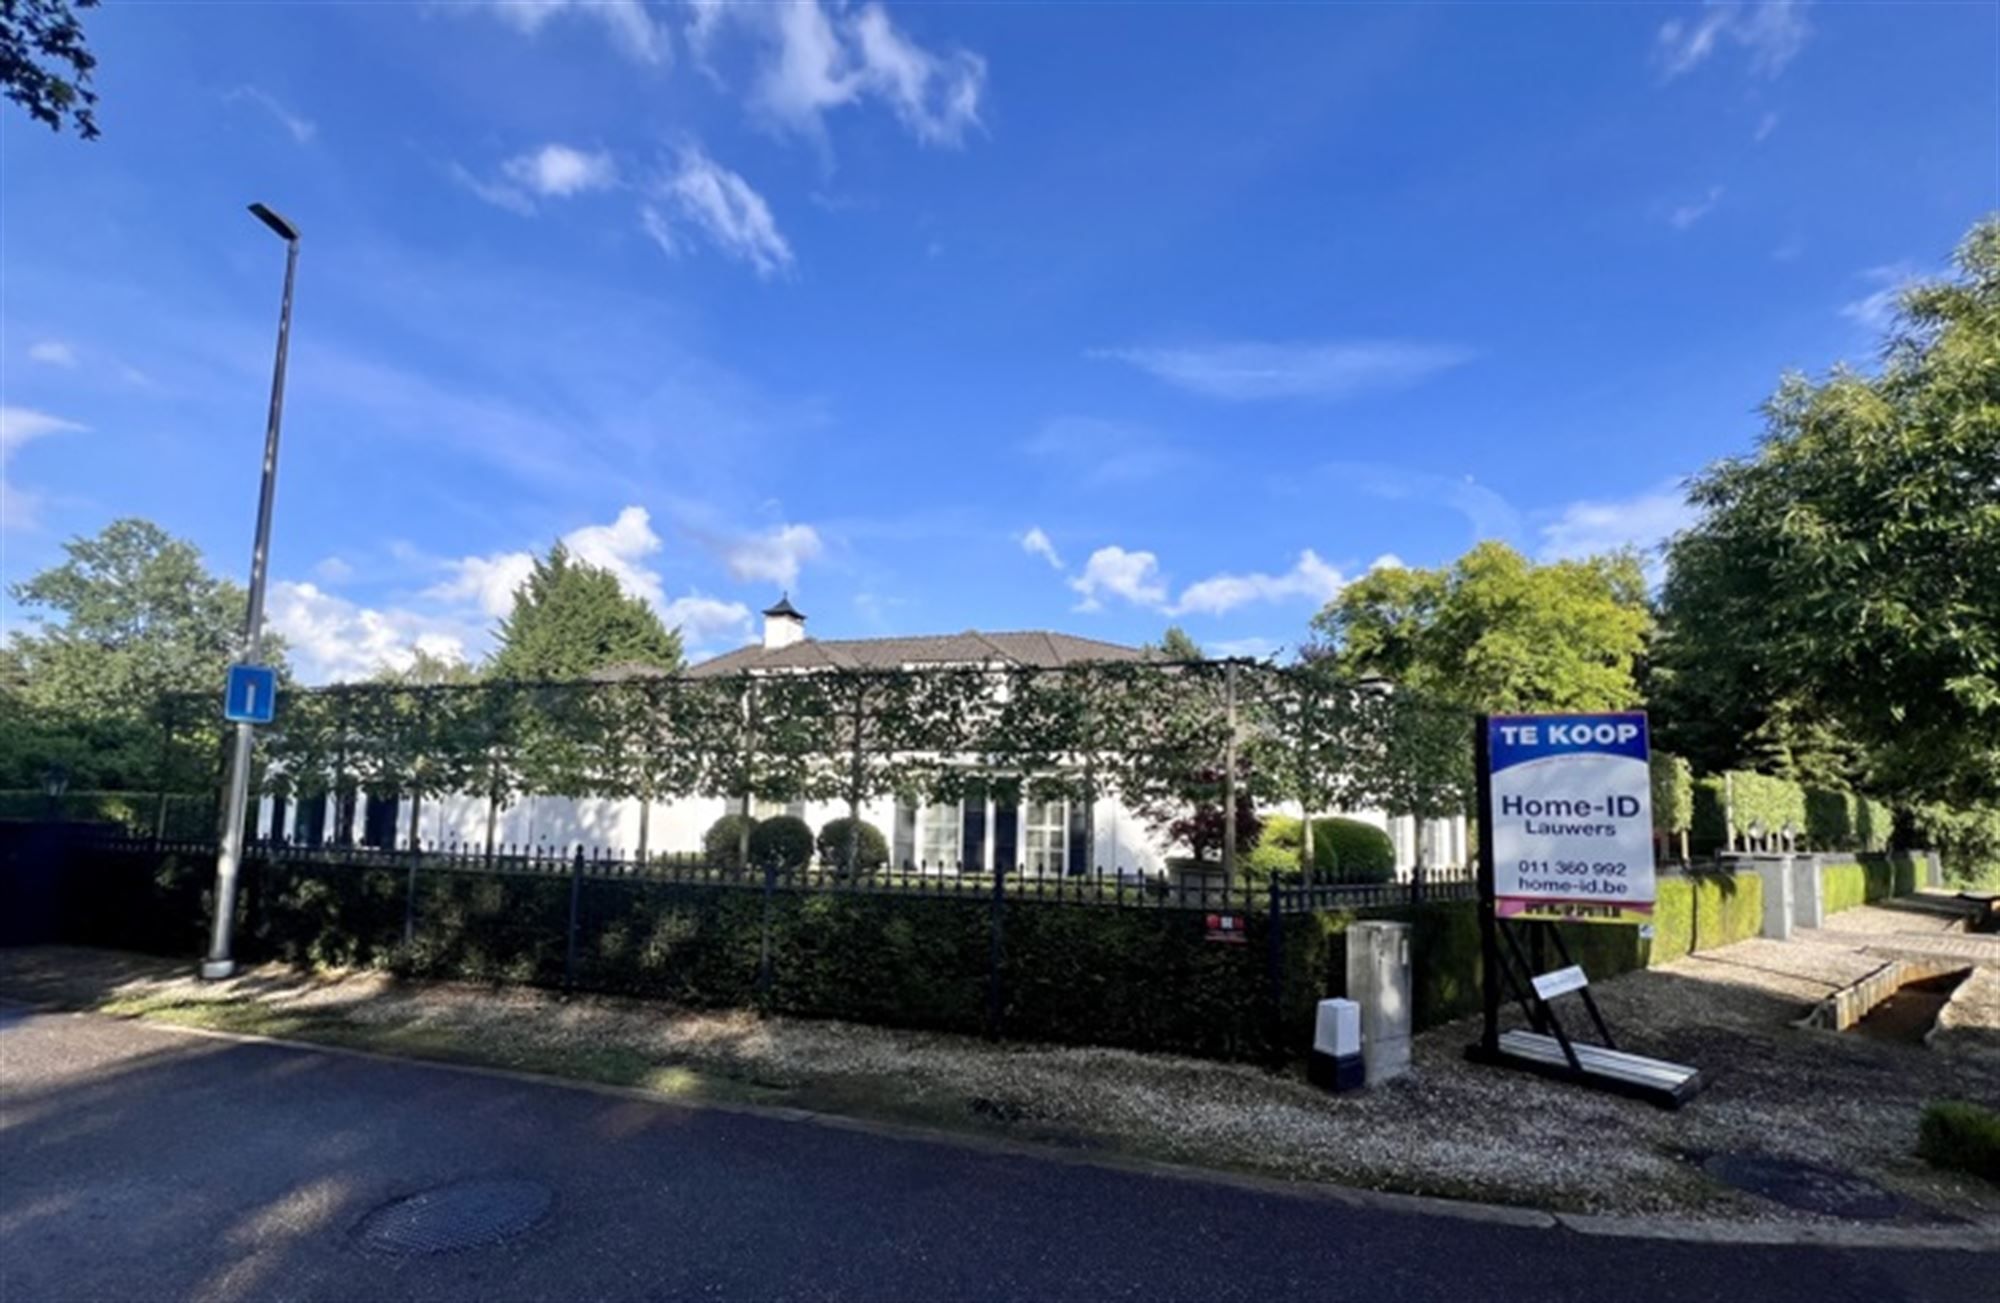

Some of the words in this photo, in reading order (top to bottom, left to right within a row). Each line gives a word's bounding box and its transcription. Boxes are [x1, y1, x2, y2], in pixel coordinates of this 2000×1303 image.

[1500, 725, 1538, 745] TE
[1549, 724, 1638, 744] KOOP
[1502, 796, 1640, 818] Home-ID
[1525, 820, 1616, 837] Lauwers
[1518, 860, 1548, 875] 011
[1555, 861, 1588, 876] 360
[1593, 863, 1626, 877] 992
[1518, 877, 1628, 894] home-id.be
